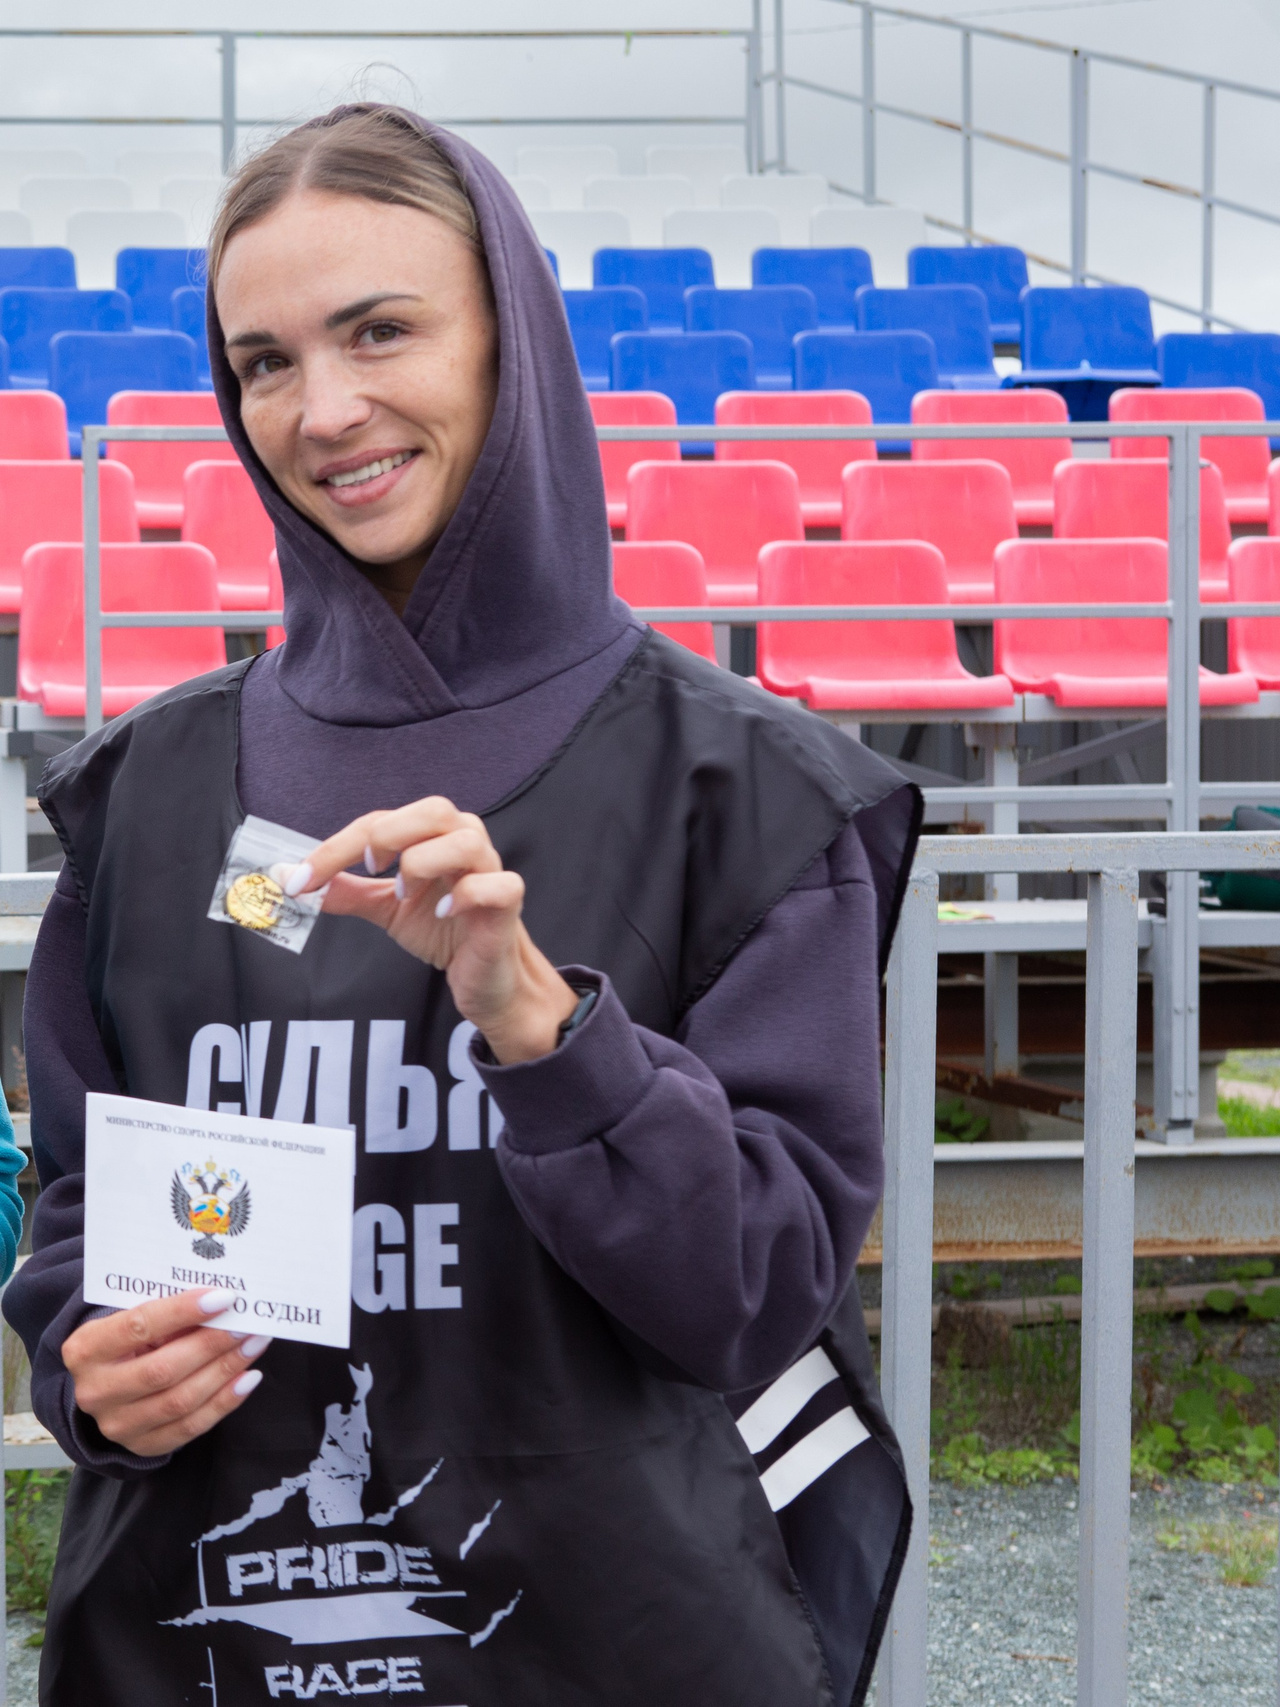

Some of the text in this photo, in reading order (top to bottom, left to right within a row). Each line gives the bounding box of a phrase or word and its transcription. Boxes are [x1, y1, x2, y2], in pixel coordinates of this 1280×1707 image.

[104, 1115, 172, 1135] МИНИСТЕРСТВО
[173, 1125, 207, 1139] СПОРТА
[171, 1266, 247, 1291] КНИЖКА
[254, 1297, 322, 1326] СУДЬИ
[226, 1539, 442, 1597] PRIDE
[263, 1655, 425, 1699] RACE
